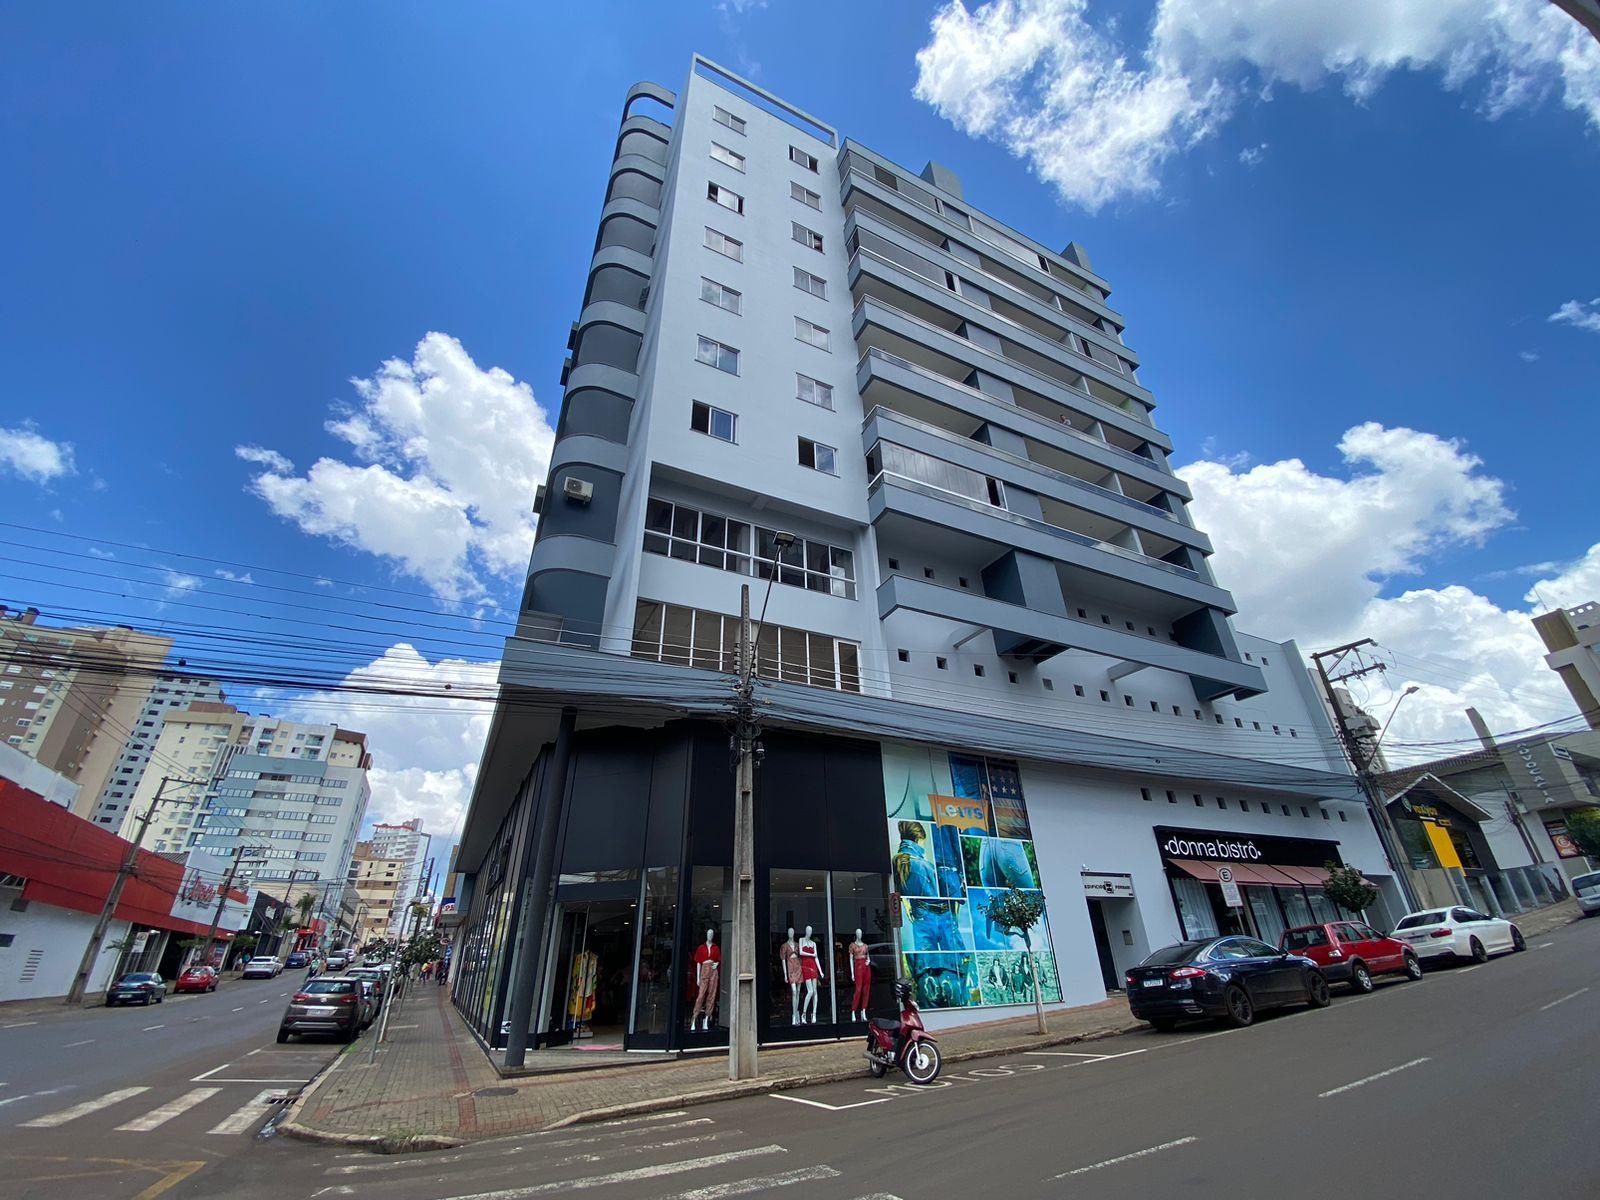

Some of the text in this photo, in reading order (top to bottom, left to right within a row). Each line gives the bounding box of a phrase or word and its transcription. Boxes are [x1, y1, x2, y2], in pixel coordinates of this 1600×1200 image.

[1168, 836, 1258, 860] donna bistrô
[1221, 871, 1229, 879] E
[864, 1063, 1045, 1097] MOTOS
